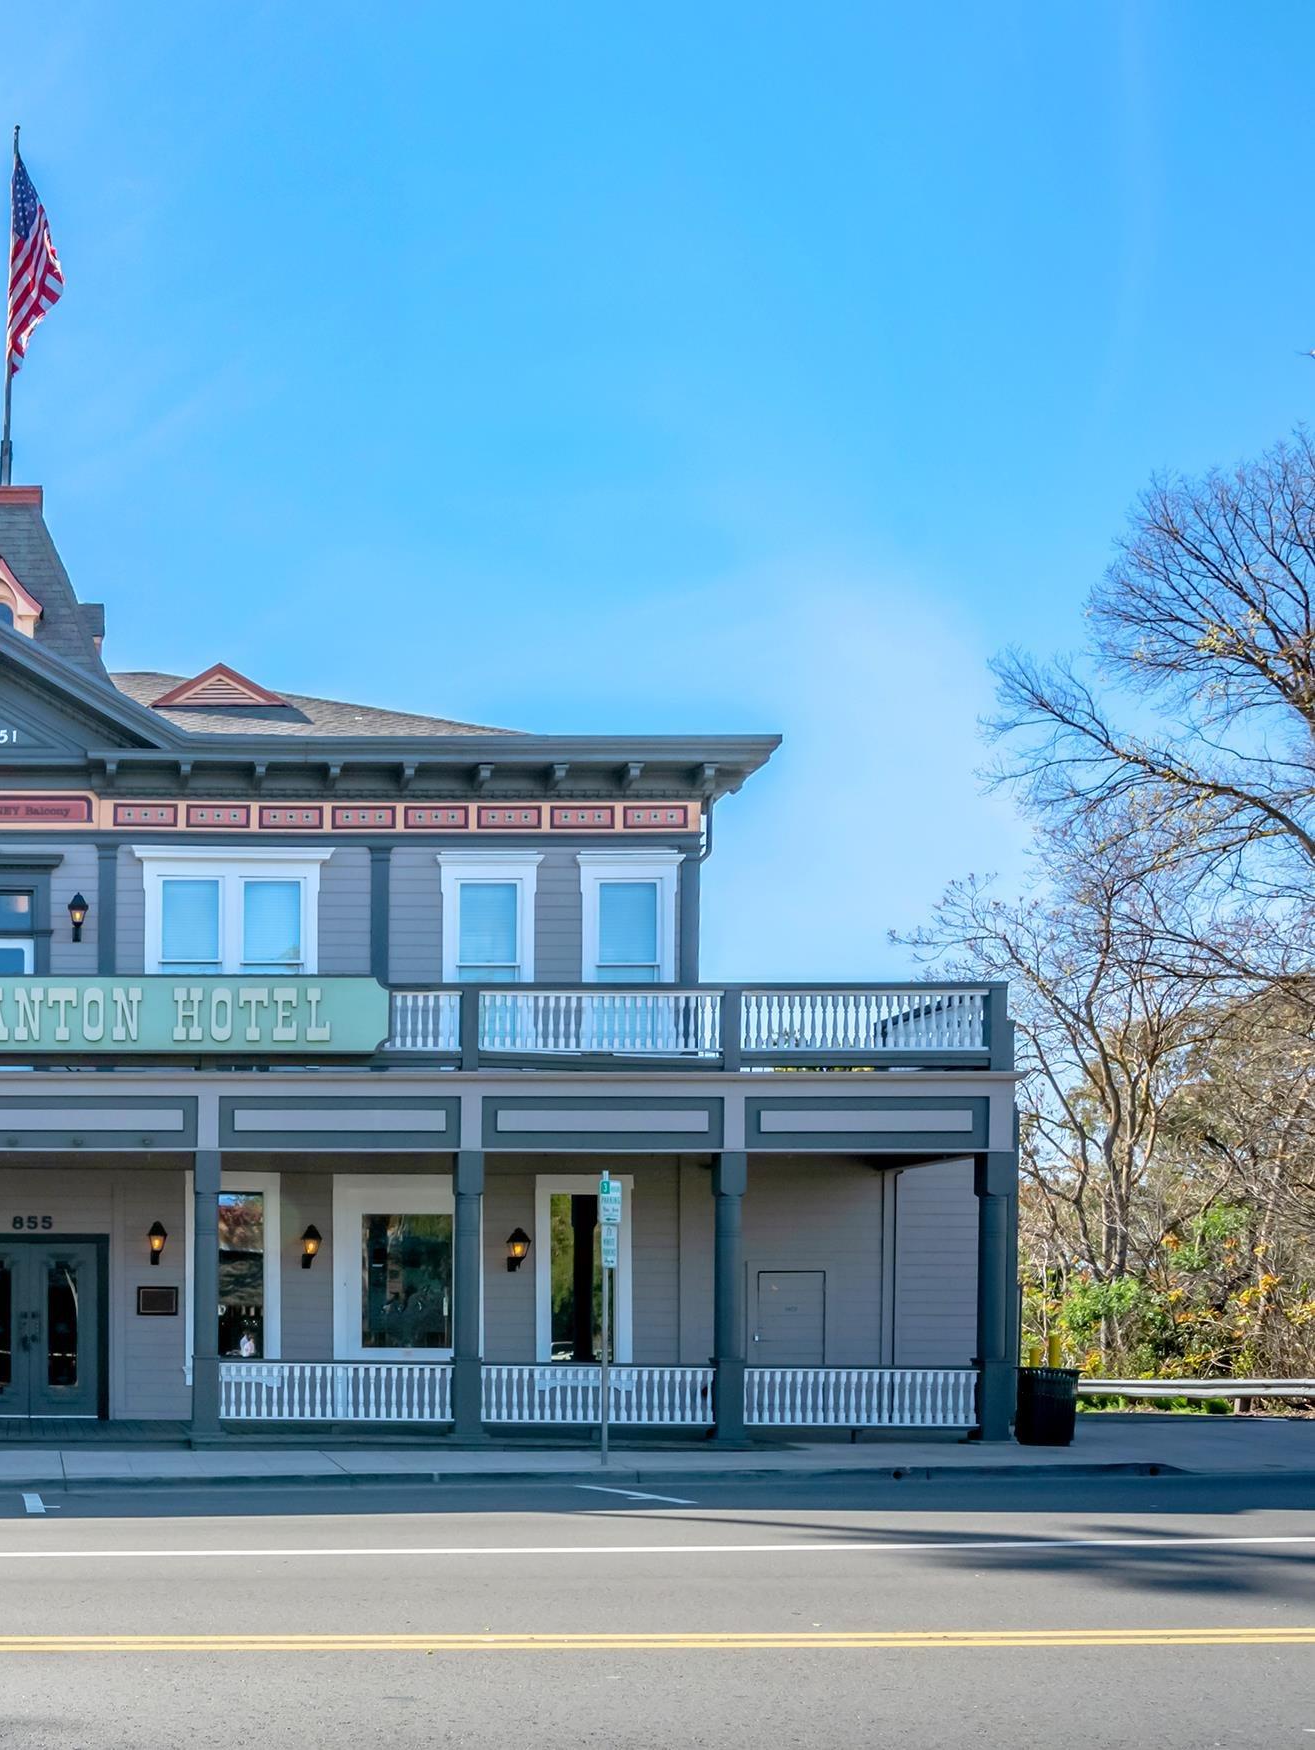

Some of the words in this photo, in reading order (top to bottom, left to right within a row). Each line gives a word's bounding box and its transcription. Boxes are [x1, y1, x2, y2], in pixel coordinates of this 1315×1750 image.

[25, 806, 71, 818] Balcony
[172, 986, 332, 1042] HOTEL
[12, 1215, 53, 1230] 855
